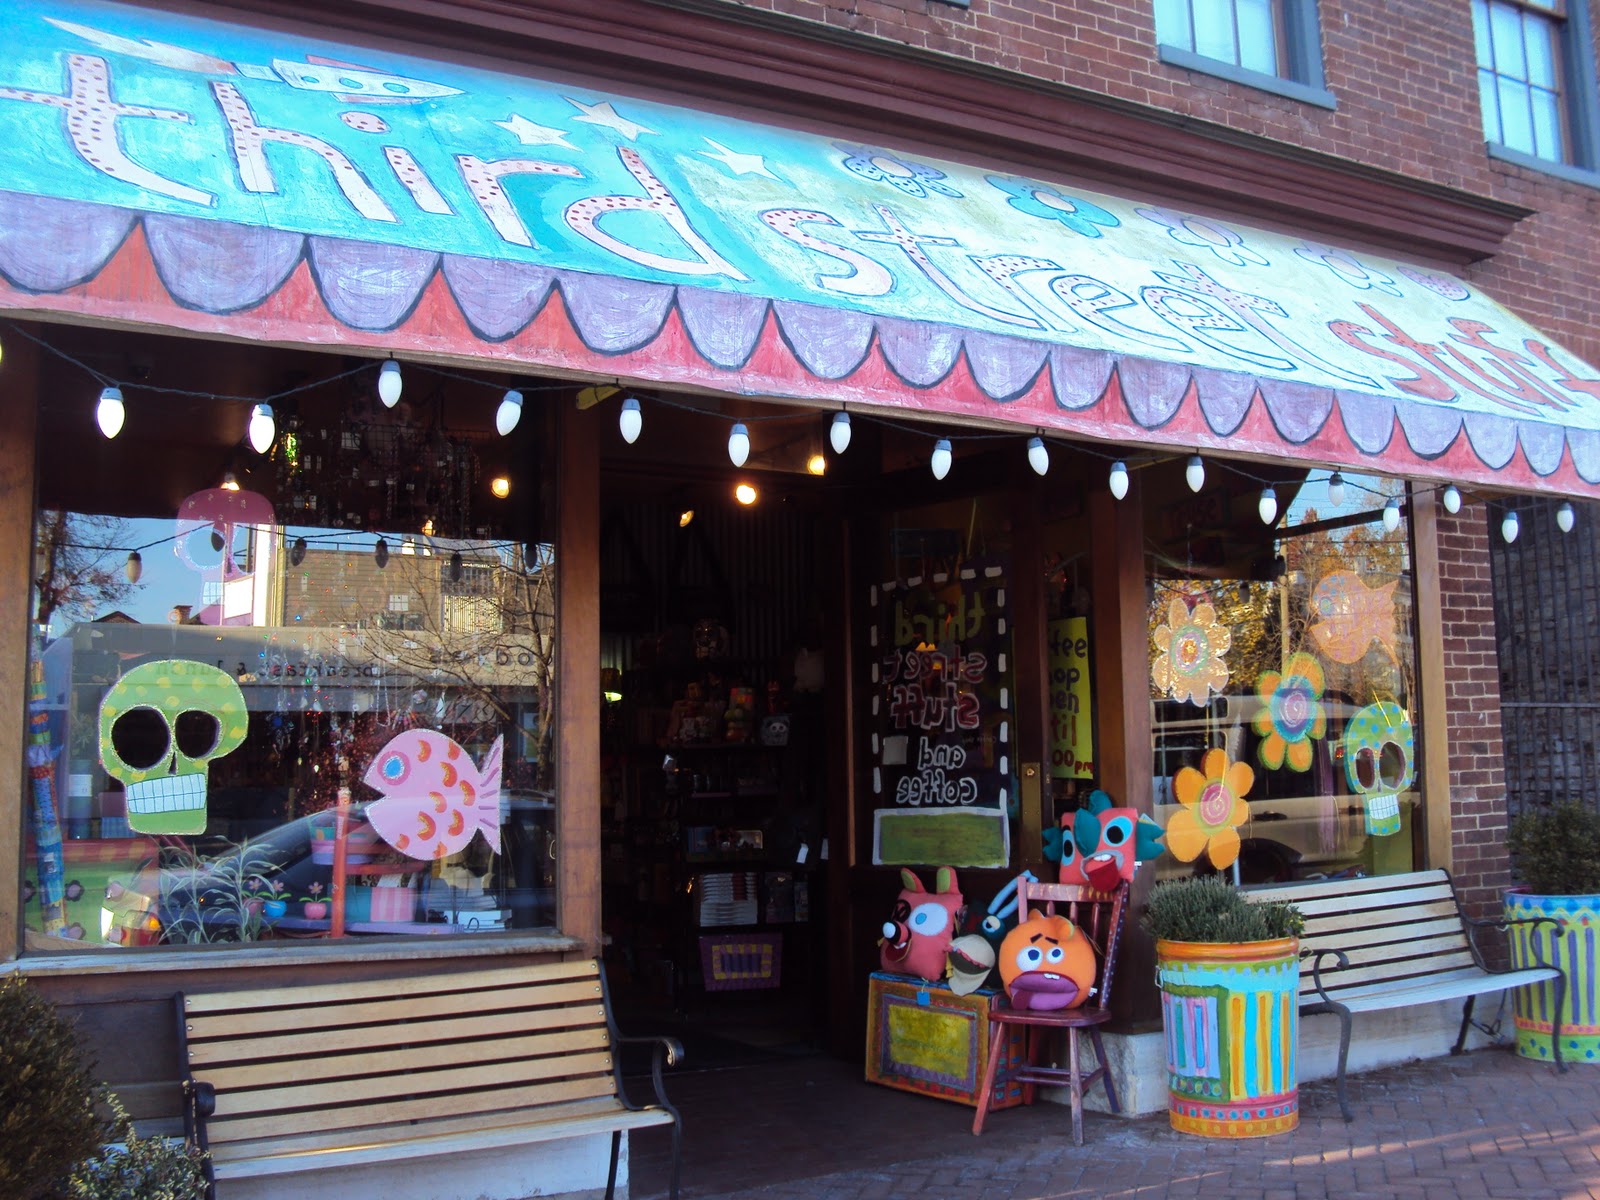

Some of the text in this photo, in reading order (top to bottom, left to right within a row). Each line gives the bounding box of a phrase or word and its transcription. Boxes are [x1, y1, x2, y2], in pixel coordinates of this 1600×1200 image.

[0, 52, 1600, 418] third street stuff
[1051, 628, 1087, 658] fee
[1049, 667, 1080, 691] op
[1049, 690, 1079, 713] en
[1051, 713, 1077, 747] til
